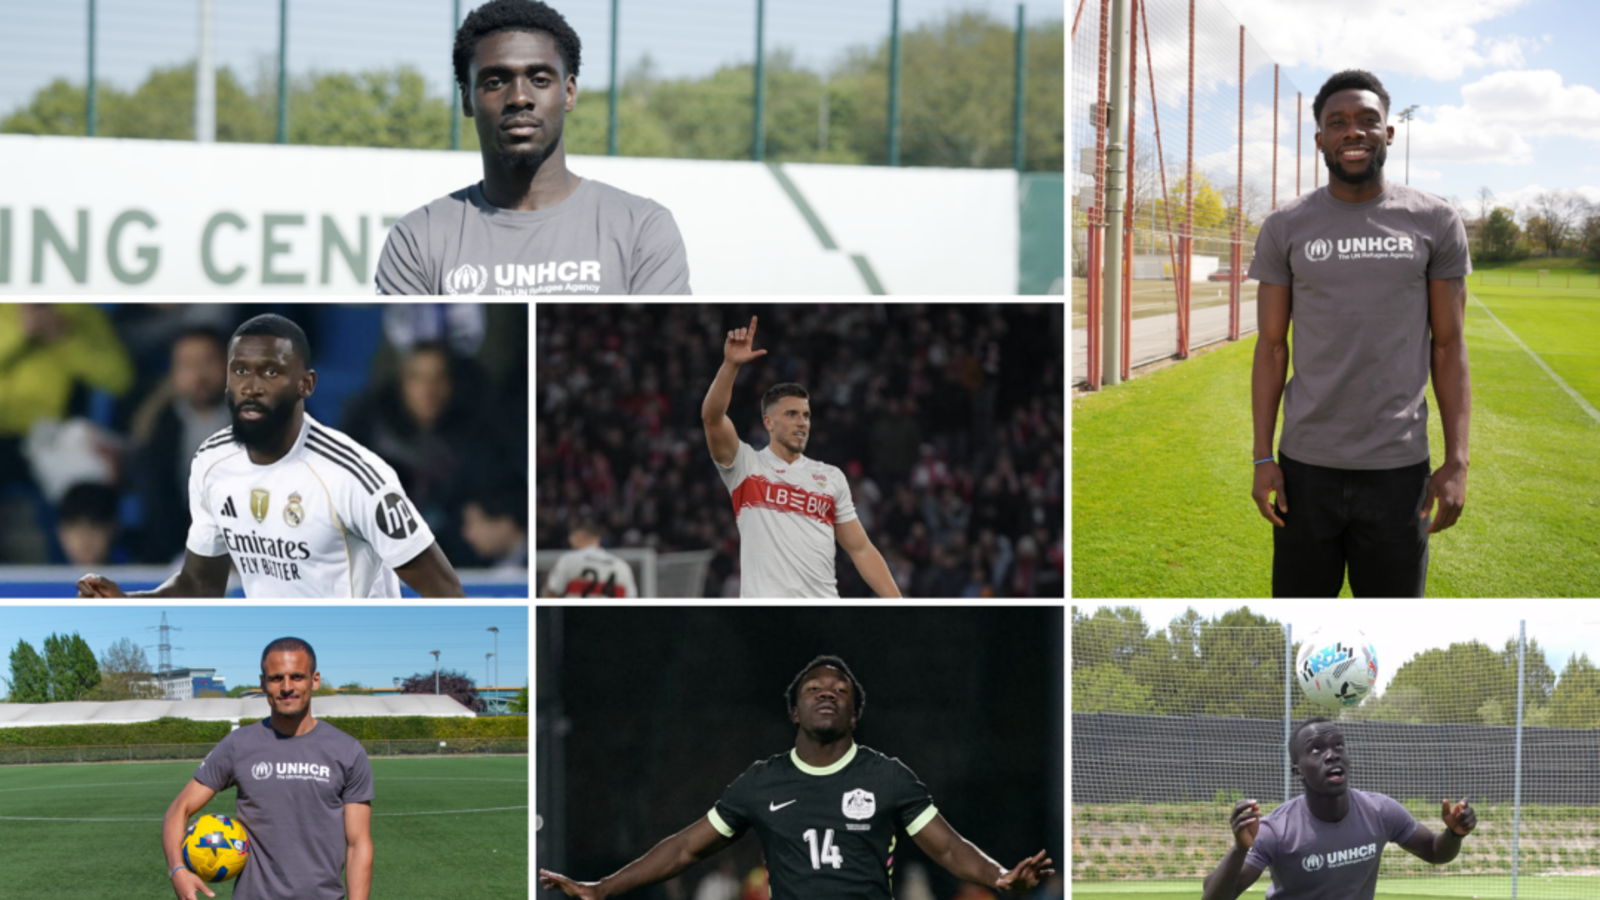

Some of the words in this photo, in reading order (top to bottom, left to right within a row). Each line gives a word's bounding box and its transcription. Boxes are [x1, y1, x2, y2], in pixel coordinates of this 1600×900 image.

[0, 207, 161, 285] ING
[1337, 237, 1414, 253] UNHCR
[495, 261, 601, 286] UNHCR
[529, 283, 563, 295] Refugee
[565, 282, 600, 293] Agency
[379, 496, 415, 539] hp
[223, 527, 311, 561] Emirates
[240, 556, 260, 574] FLY
[581, 568, 616, 598] 24
[276, 762, 330, 778] UNHCR
[803, 828, 843, 870] 14
[1326, 843, 1377, 864] UNHCR
